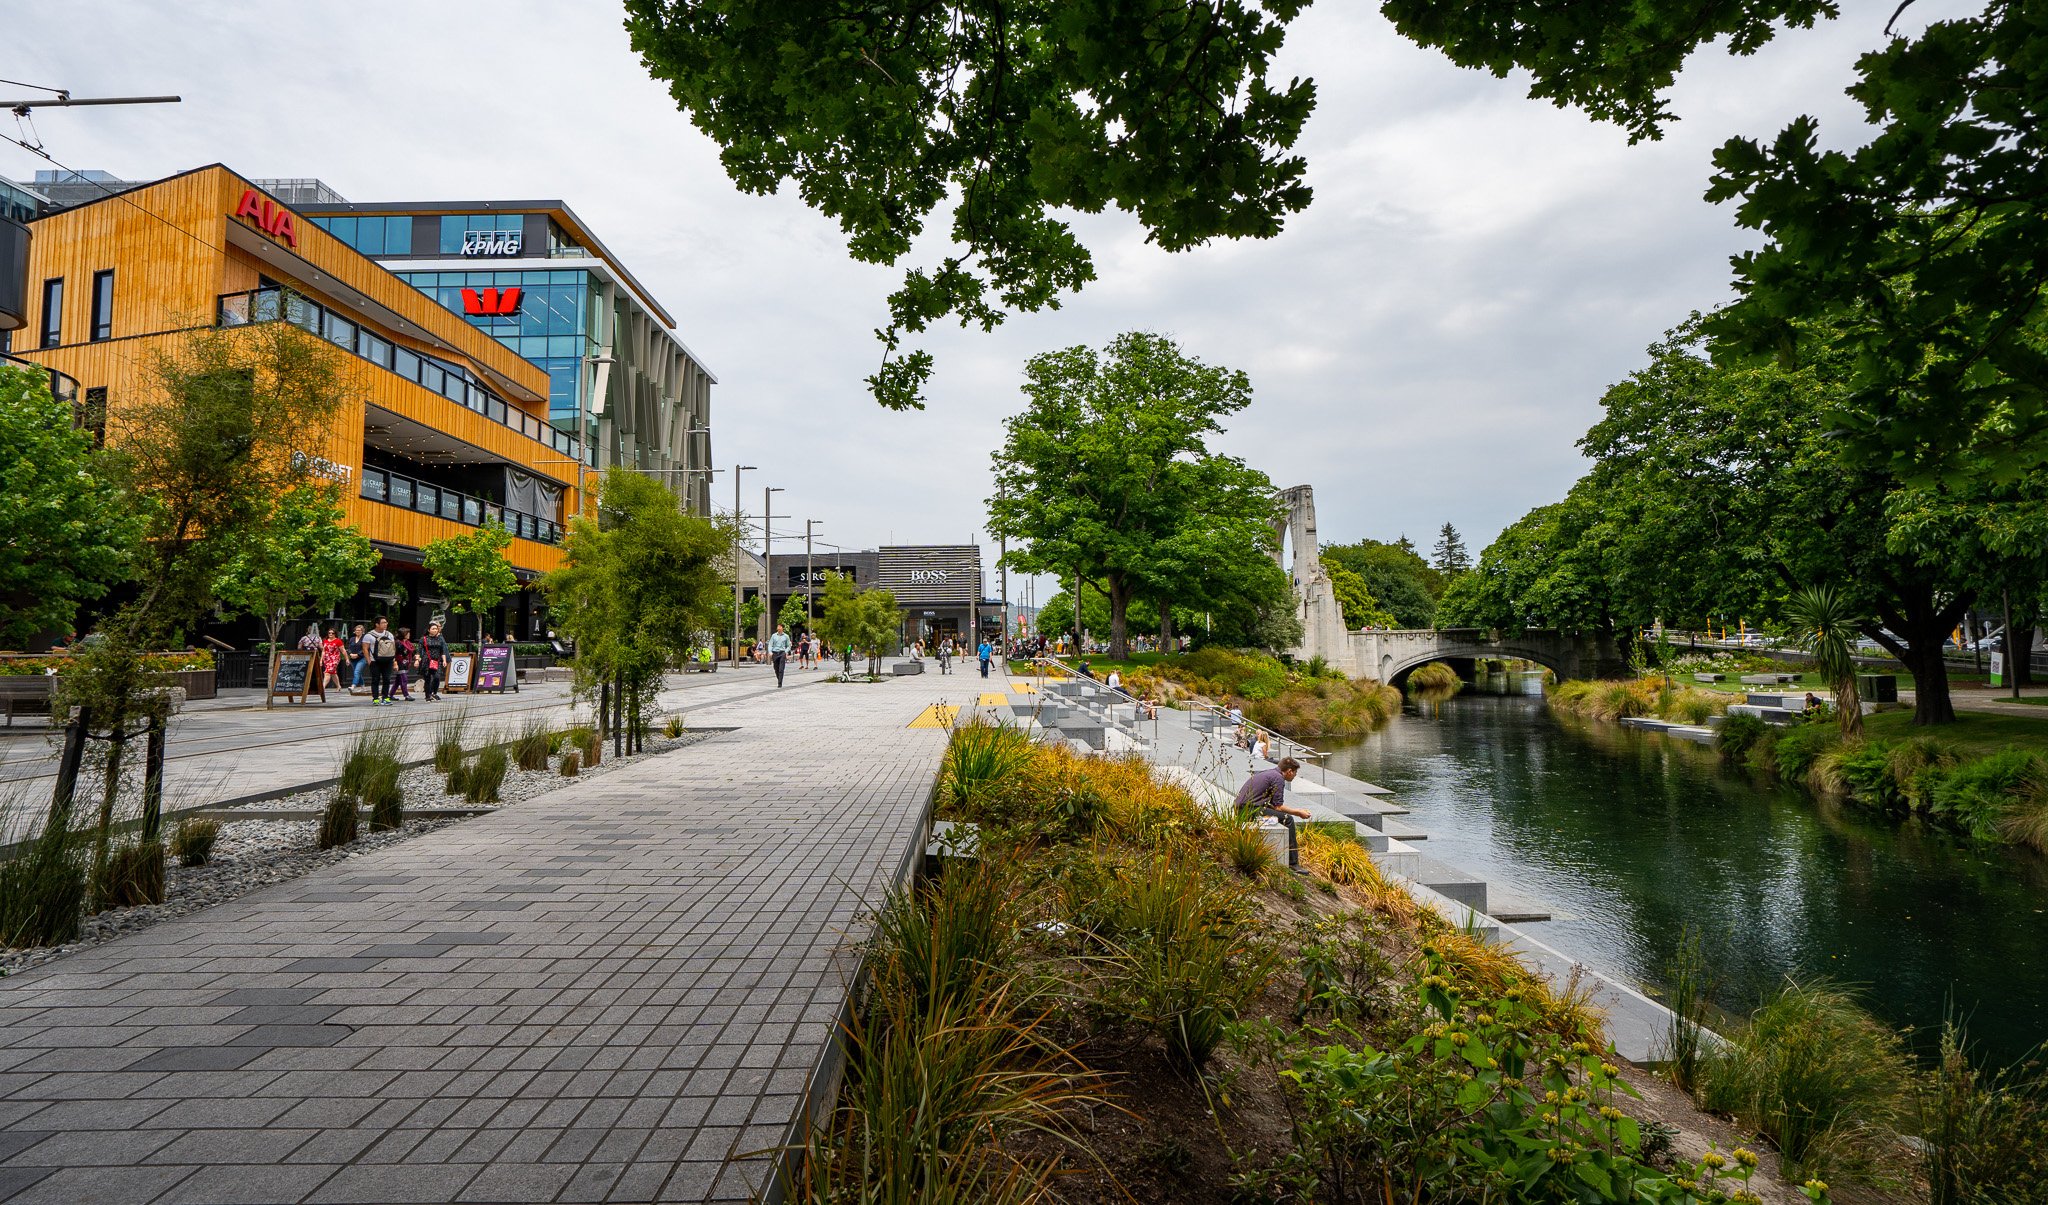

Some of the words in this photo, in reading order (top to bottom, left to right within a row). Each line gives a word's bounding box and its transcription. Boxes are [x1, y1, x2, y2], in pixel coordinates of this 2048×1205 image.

[236, 190, 297, 247] AIA
[460, 240, 519, 255] KPMG
[314, 457, 353, 478] CRAFT
[369, 479, 385, 487] CRAFT
[397, 487, 411, 495] CRAFT
[423, 494, 437, 502] CRAFT
[800, 572, 845, 581] SRGS
[911, 570, 947, 581] BOSS
